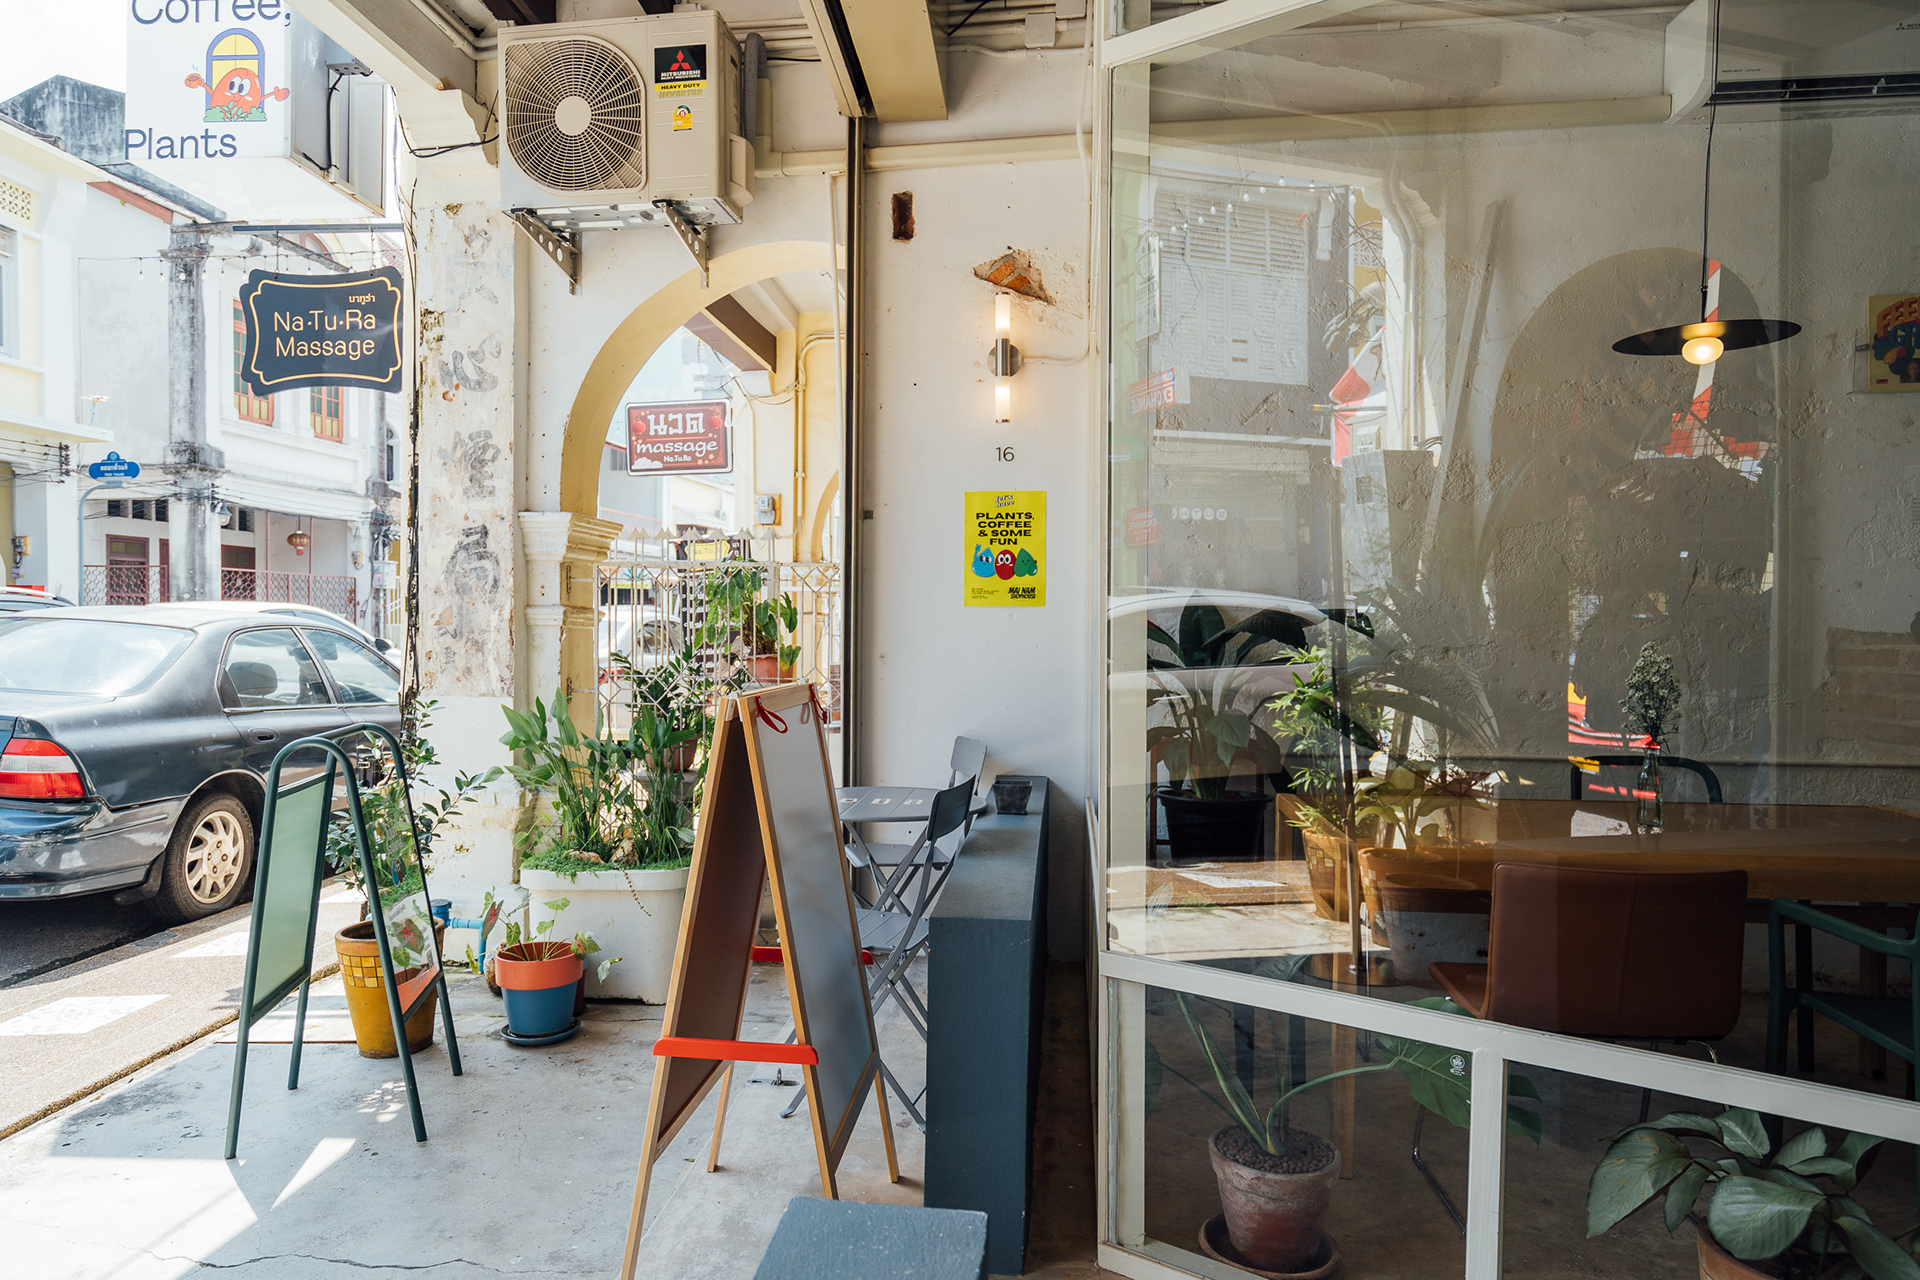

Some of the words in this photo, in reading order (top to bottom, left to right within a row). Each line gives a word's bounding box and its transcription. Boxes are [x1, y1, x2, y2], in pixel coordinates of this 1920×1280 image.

[131, 0, 291, 27] Coffee,
[661, 69, 701, 78] MITSUBISHI
[659, 89, 703, 98] INVERTER
[124, 127, 238, 160] Plants
[1876, 296, 1920, 338] FEE
[275, 337, 375, 361] Massage
[647, 412, 706, 435] นวด
[636, 441, 719, 457] massage
[995, 446, 1015, 462] 16
[995, 500, 1015, 508] have
[975, 512, 1035, 520] PLANTS,
[991, 529, 1032, 537] SOME
[1008, 586, 1021, 594] MAI
[1021, 586, 1036, 594] NAM
